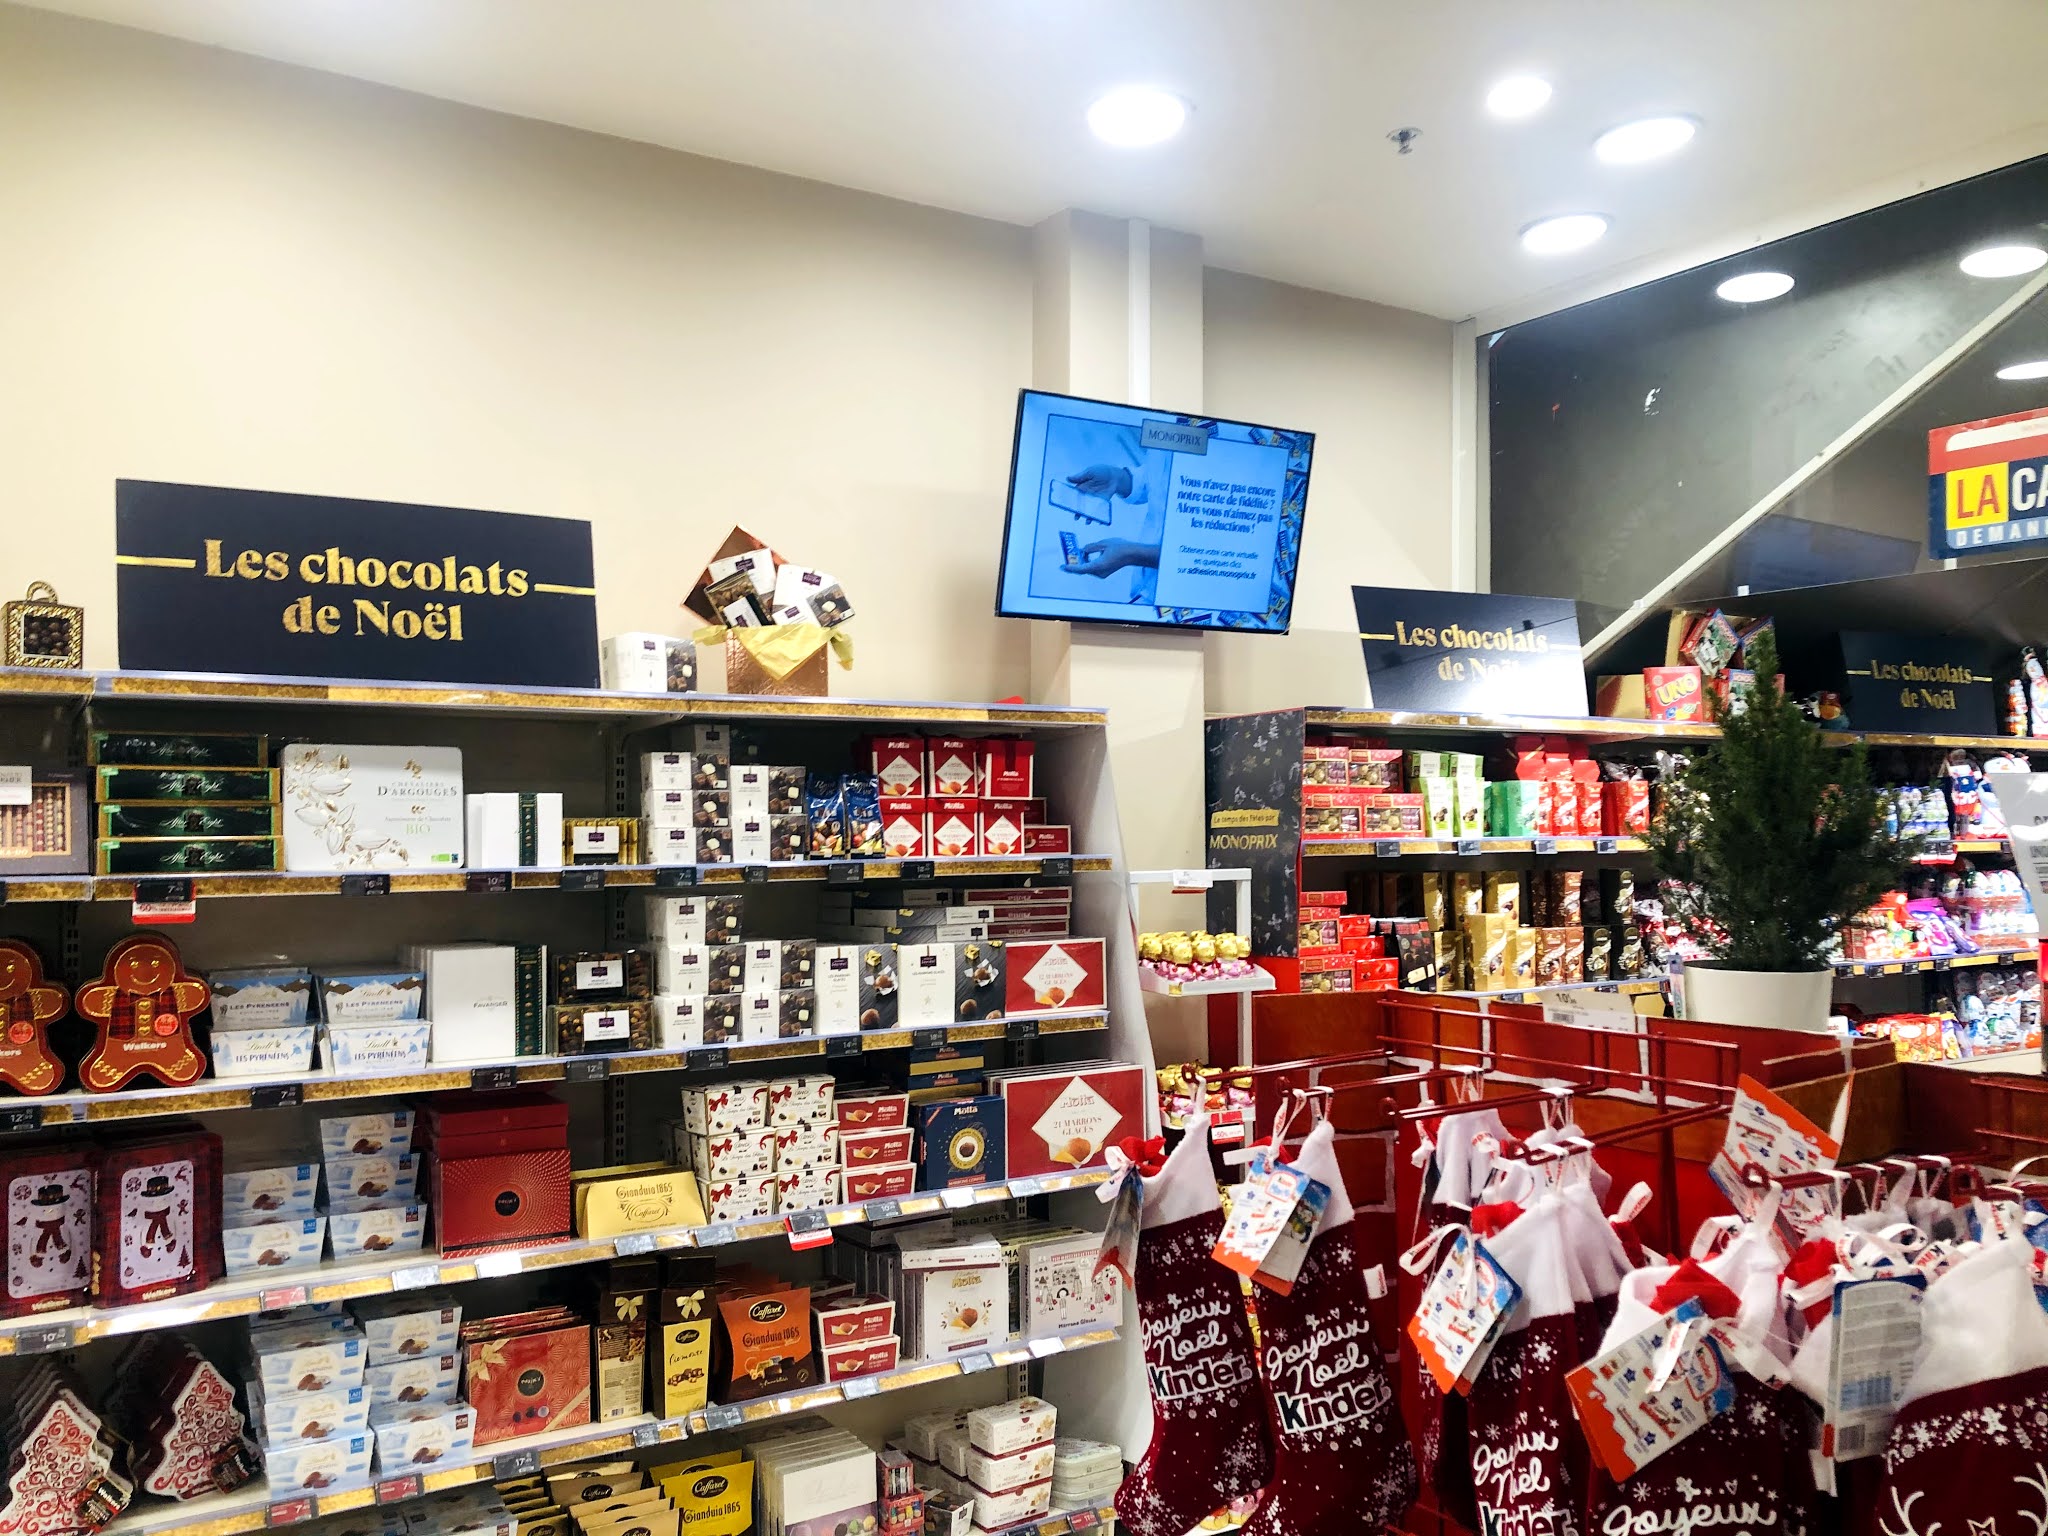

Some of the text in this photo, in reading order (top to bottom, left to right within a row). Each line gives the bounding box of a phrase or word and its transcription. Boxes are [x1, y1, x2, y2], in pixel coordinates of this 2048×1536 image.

[1147, 429, 1202, 446] MONOPRIX
[1180, 475, 1276, 498] Vous n'avez pas encore
[1956, 474, 2002, 519] LA
[1177, 491, 1202, 501] notre
[1202, 493, 1226, 503] carte
[1226, 495, 1238, 506] de
[1238, 496, 1268, 510] fidélité
[1176, 502, 1274, 524] Alors vous n'aimez pas
[1190, 517, 1203, 528] les
[1204, 519, 1250, 533] réductions
[204, 537, 530, 598] Les chocolats
[281, 594, 465, 642] de Noël
[1395, 620, 1549, 653] Les chocolats
[1438, 656, 1465, 681] de
[1871, 659, 1974, 685] Les chocolats
[1656, 673, 1700, 706] UNO
[1901, 687, 1956, 711] de Noël
[1210, 834, 1278, 850] MONOPRIX
[123, 1040, 166, 1052] Walkers
[954, 1106, 978, 1116] Motta
[616, 1181, 674, 1199] Gianduia 1865
[752, 1303, 783, 1320] Caffarel
[1141, 1300, 1232, 1351] Joyeux
[742, 1330, 783, 1348] Gianduia
[1152, 1320, 1228, 1365] Noël
[1266, 1319, 1370, 1381] Joyeux
[669, 1350, 703, 1366] Piemonte
[1287, 1342, 1370, 1394] Noël
[97, 1487, 122, 1510] Walkers
[694, 1479, 726, 1496] Caffarel
[683, 1501, 741, 1524] Gianduia 1865
